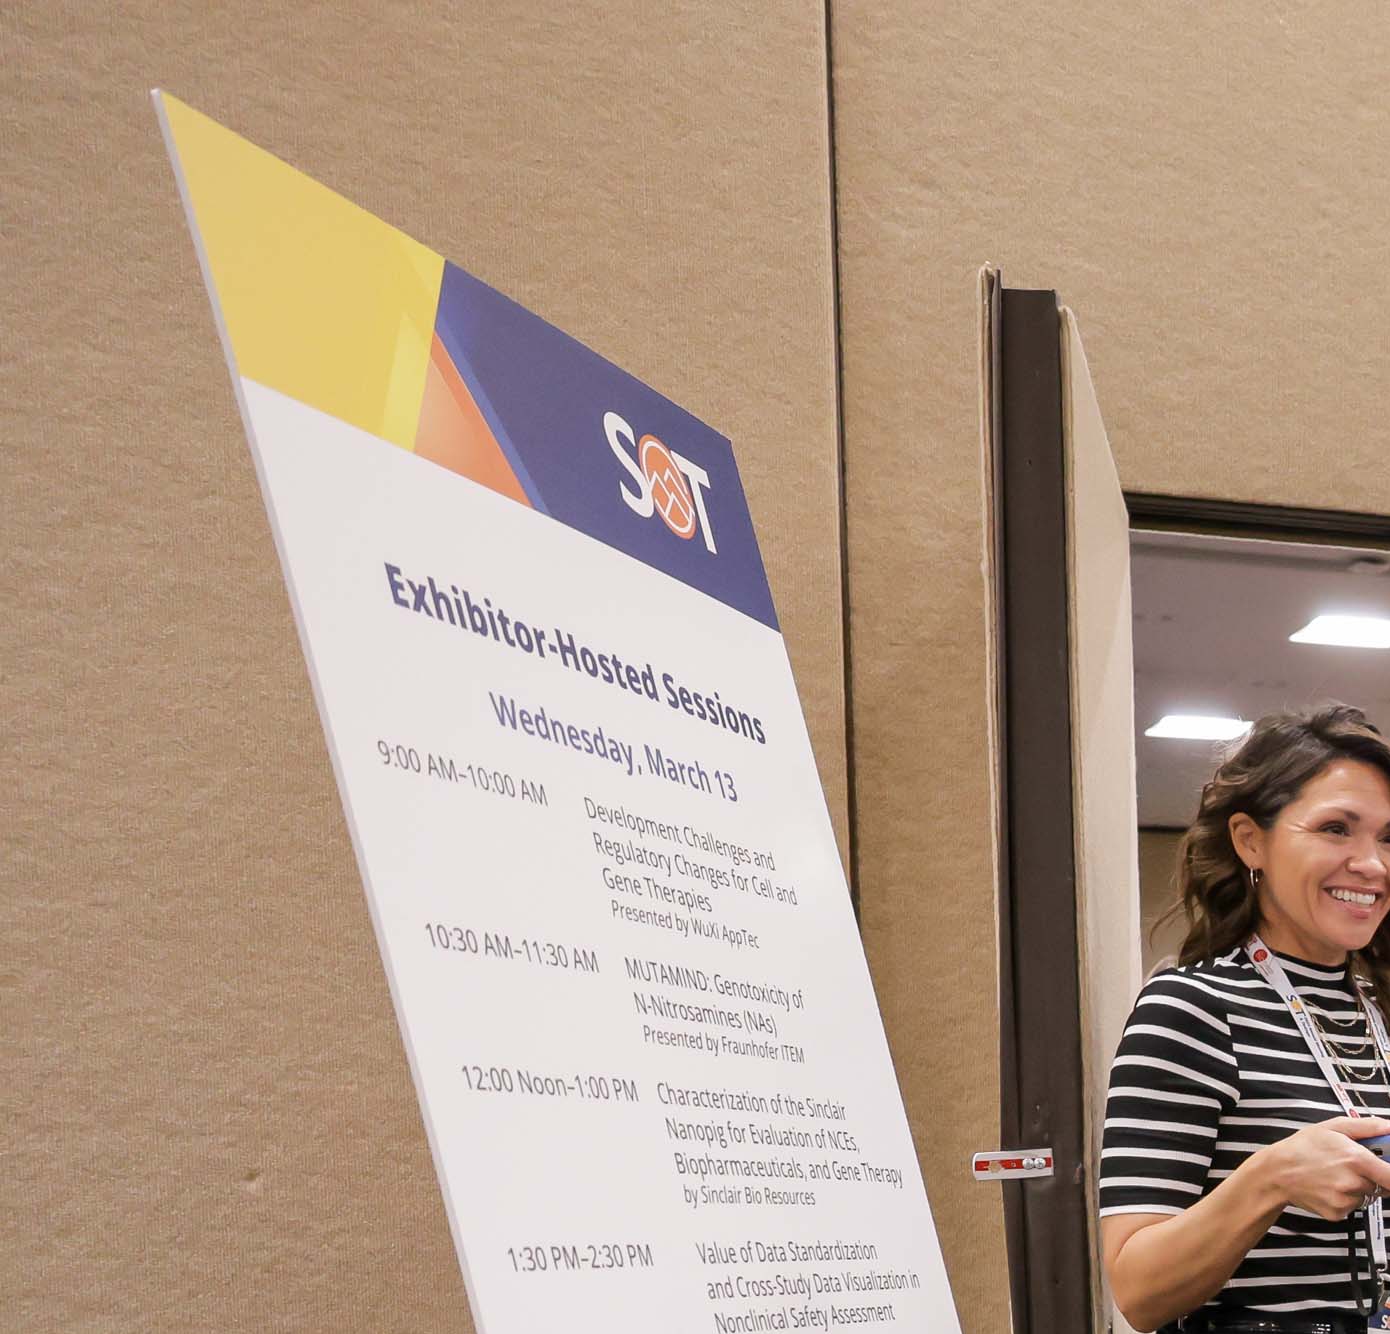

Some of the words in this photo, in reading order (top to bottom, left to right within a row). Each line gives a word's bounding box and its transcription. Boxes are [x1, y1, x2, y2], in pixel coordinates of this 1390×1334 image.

[603, 411, 718, 555] SOT
[384, 562, 661, 703] Exhibitor-Hosted
[662, 672, 767, 746] Sessions
[488, 691, 643, 777] Wednesday,
[643, 744, 713, 795] March
[714, 770, 738, 803] 13
[377, 740, 422, 774] 9:00
[521, 779, 549, 807] AM
[583, 796, 683, 845] Development
[683, 826, 752, 867] Challenges
[753, 851, 777, 872] and
[592, 832, 672, 878] Regulatory
[674, 854, 731, 891] Changes
[730, 868, 749, 893] for
[751, 875, 775, 900] Cell
[775, 886, 799, 906] and
[602, 867, 644, 897] Gene
[642, 876, 713, 914] Therapies
[611, 899, 673, 930] Presented
[674, 913, 689, 939] by
[690, 917, 720, 940] WuXi
[722, 925, 760, 950] AppTec
[425, 923, 479, 955] 10:30
[573, 948, 600, 974] AM
[624, 957, 713, 993] MUTAMIND:
[713, 974, 791, 1013] Genotoxicity
[792, 989, 805, 1010] of
[633, 992, 743, 1030] N-Nitrosamines
[743, 1010, 778, 1039] (NAs)
[643, 1024, 704, 1050] Presented
[704, 1032, 719, 1057] by
[721, 1035, 779, 1061] Fraunhofer
[780, 1045, 805, 1064] ITEM
[462, 1065, 514, 1093] 12:00
[611, 1078, 640, 1103] PM
[657, 1082, 769, 1113] Characterization
[770, 1093, 784, 1115] of
[784, 1095, 807, 1118] the
[805, 1098, 847, 1121] Sinclair
[665, 1118, 729, 1150] Nanopig
[727, 1120, 747, 1144] for
[748, 1123, 814, 1148] Evaluation
[814, 1128, 827, 1150] of
[827, 1130, 861, 1153] NCEs,
[674, 1152, 808, 1183] Biopharmaceuticals,
[808, 1159, 832, 1180] and
[831, 1160, 862, 1182] Gene
[860, 1162, 903, 1190] Therapy
[683, 1184, 699, 1210] by
[700, 1185, 743, 1205] Sinclair
[744, 1186, 763, 1205] Bio
[763, 1187, 816, 1206] Resources
[508, 1247, 548, 1273] 1:30
[626, 1244, 655, 1268] PM
[695, 1241, 739, 1265] Value
[739, 1240, 754, 1264] of
[754, 1242, 788, 1264] Data
[787, 1240, 879, 1262] Standardization
[707, 1276, 735, 1300] and
[736, 1273, 812, 1301] Cross-Study
[812, 1273, 843, 1294] Data
[841, 1270, 910, 1292] Visualization
[908, 1270, 921, 1289] in
[714, 1307, 790, 1334] Nonclinical
[789, 1305, 829, 1333] Safety
[831, 1304, 896, 1326] Assessment
